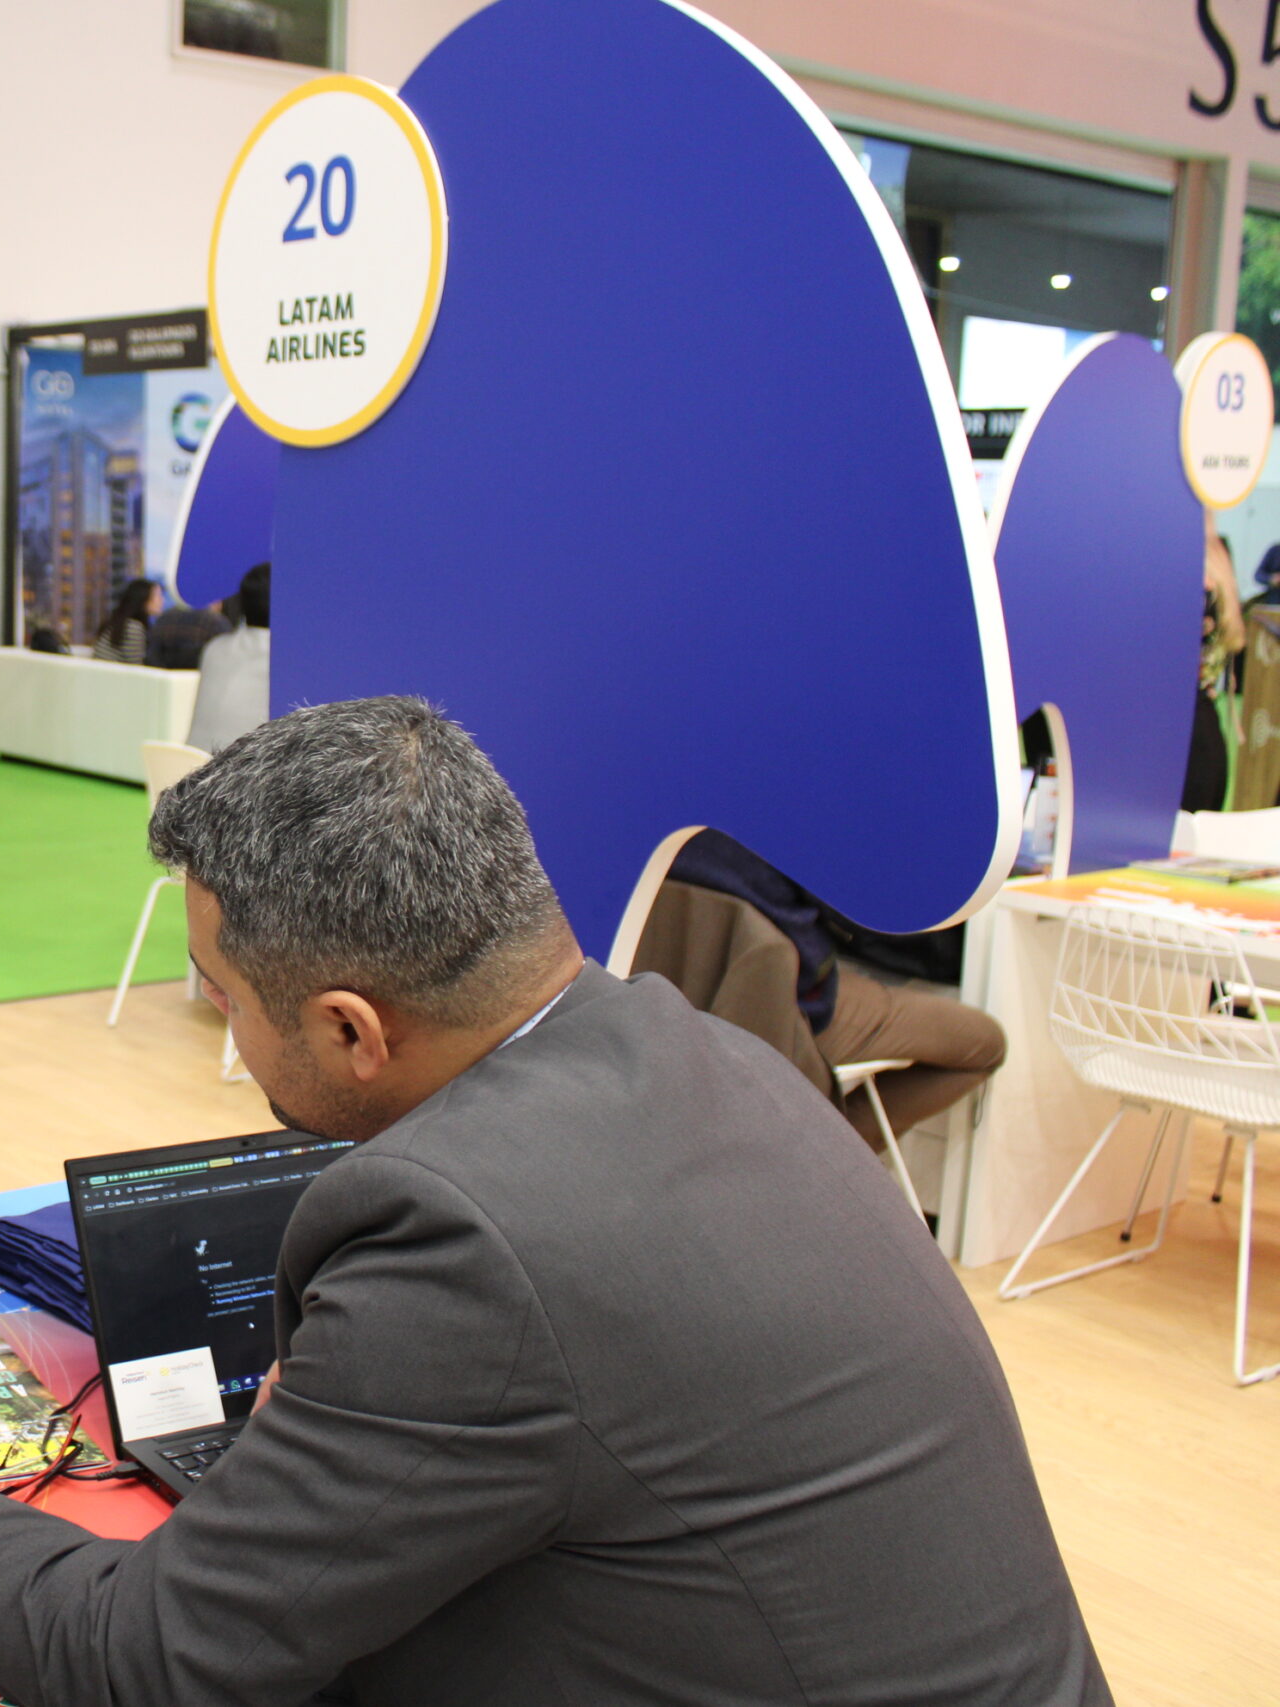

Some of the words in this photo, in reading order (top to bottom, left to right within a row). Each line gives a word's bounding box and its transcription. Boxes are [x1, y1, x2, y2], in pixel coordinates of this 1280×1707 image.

[282, 154, 356, 243] 20
[279, 293, 354, 326] LATAM
[266, 329, 367, 364] AIRLINES
[1216, 373, 1245, 411] 03
[11, 1384, 28, 1397] A
